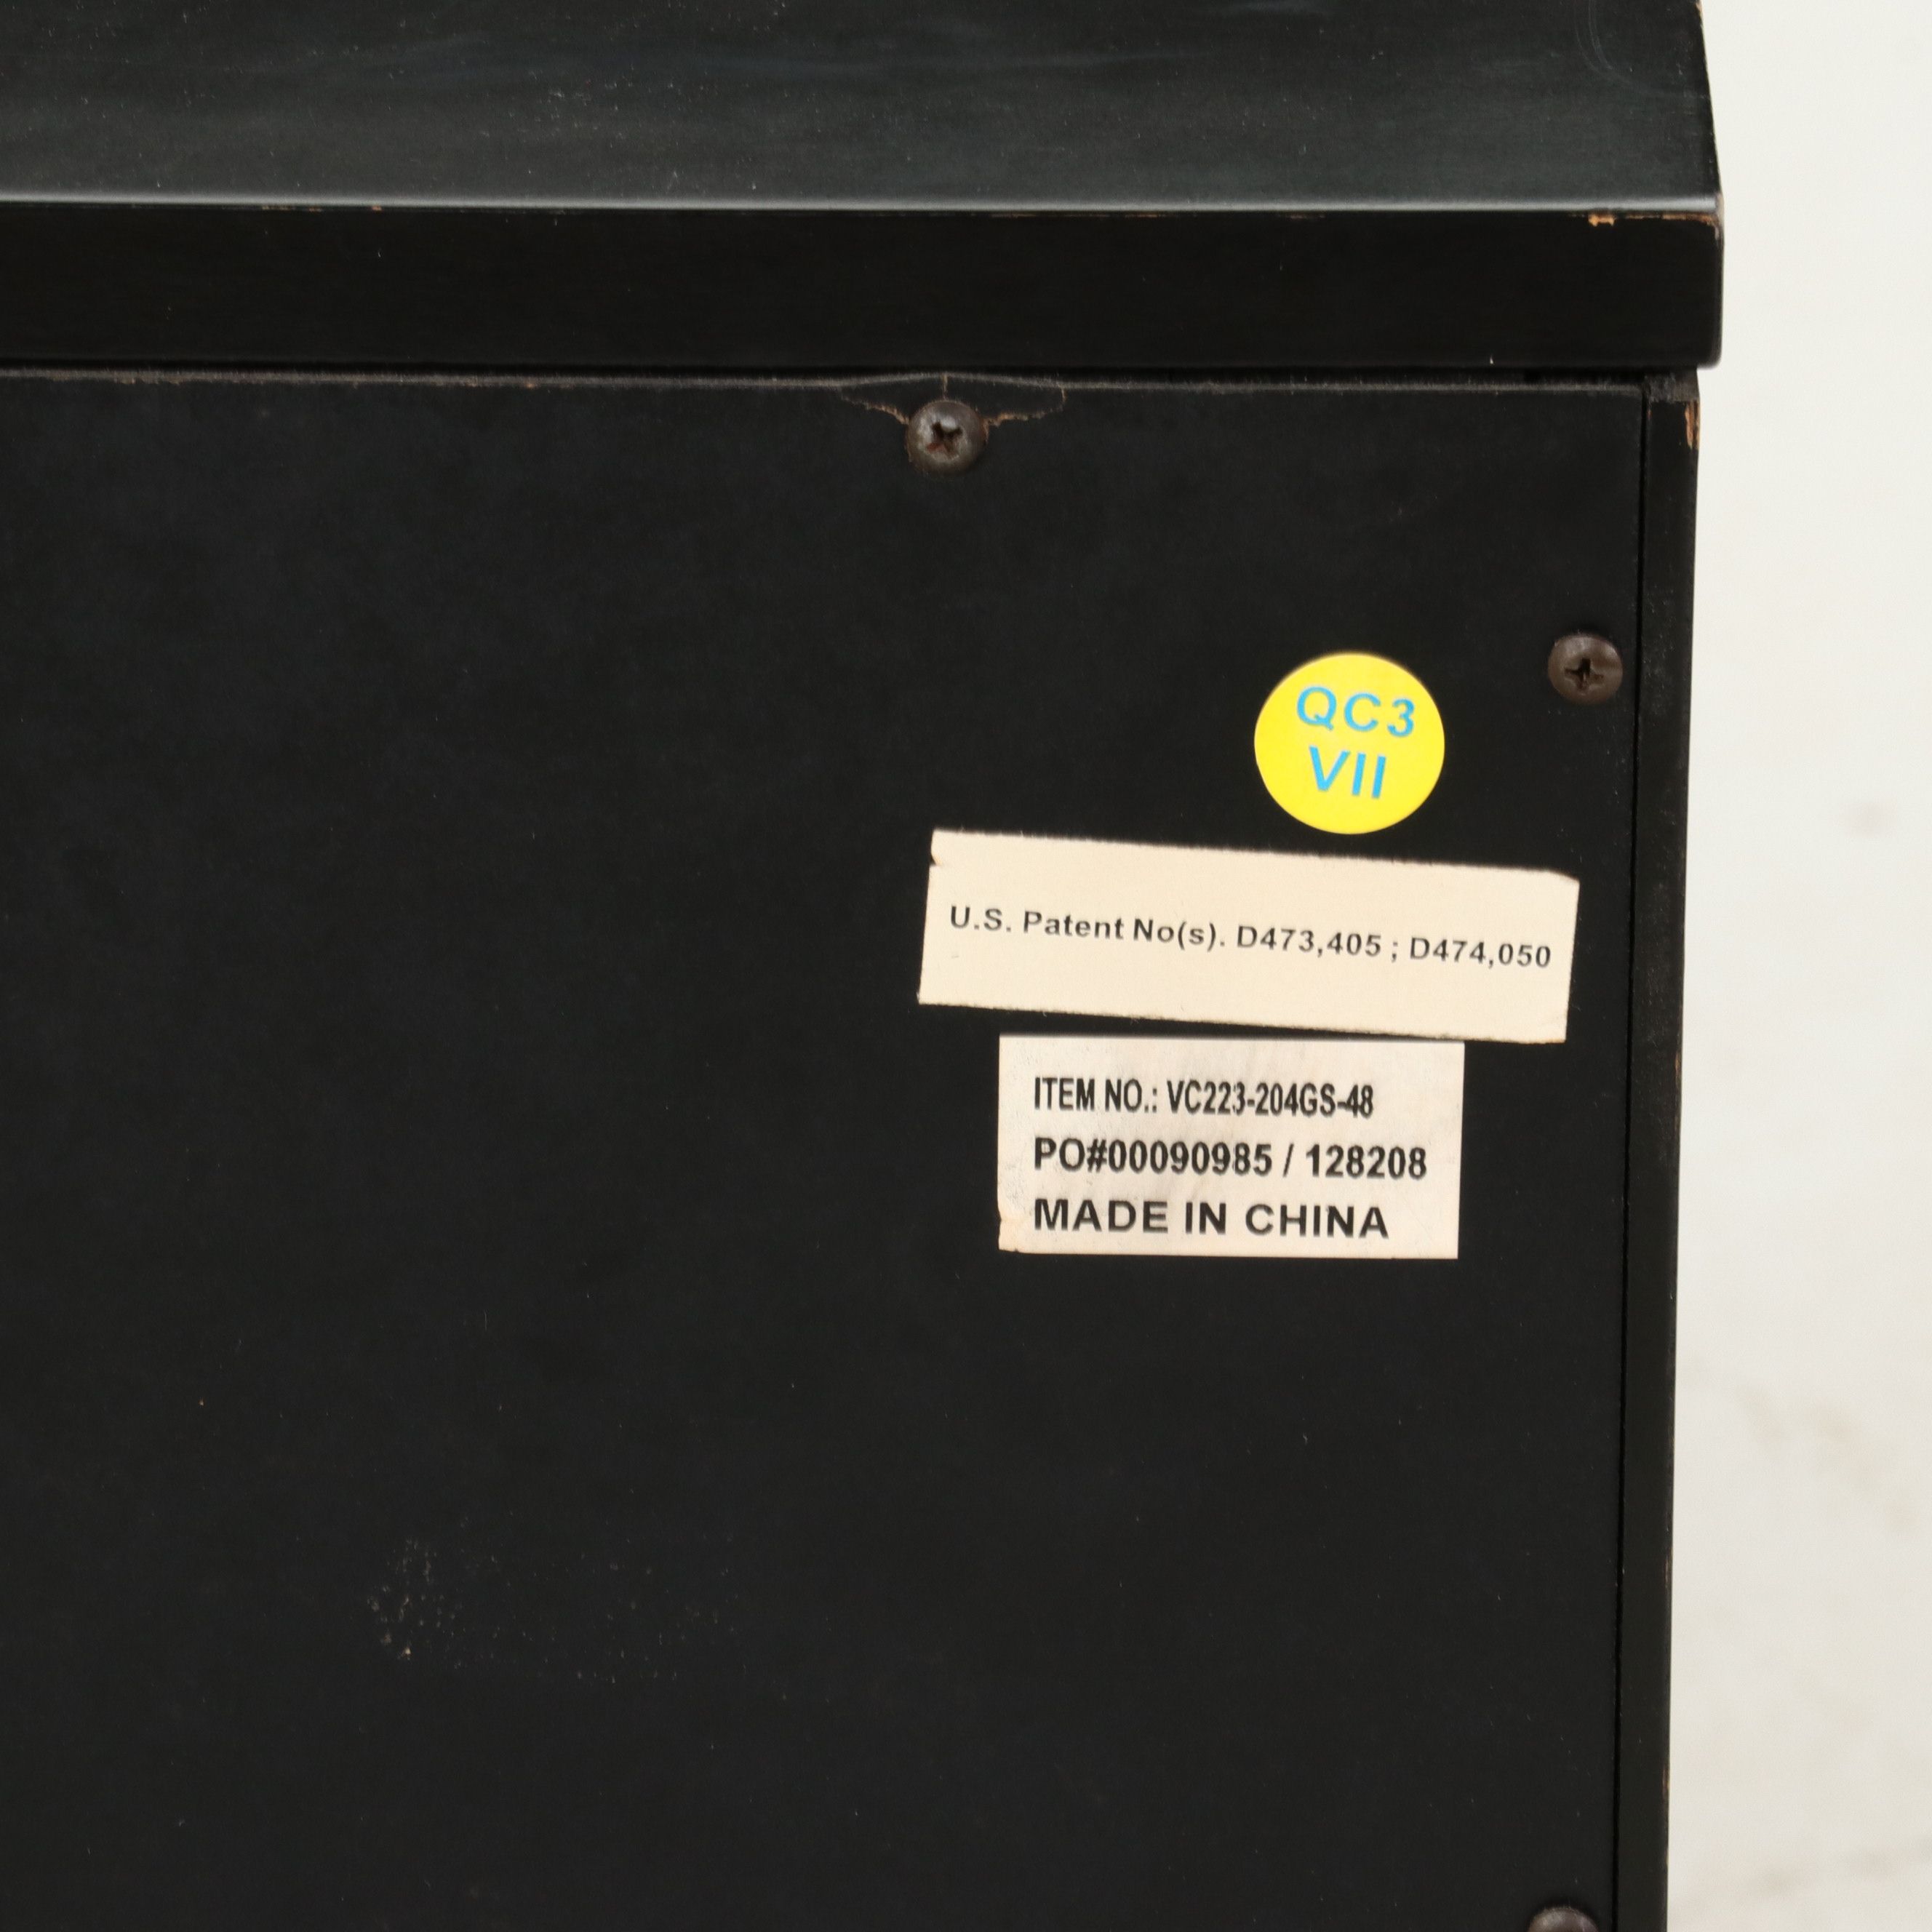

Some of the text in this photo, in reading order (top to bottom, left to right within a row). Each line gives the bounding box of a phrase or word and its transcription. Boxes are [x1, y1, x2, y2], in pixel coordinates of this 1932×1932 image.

[1297, 687, 1415, 737] QC3
[1309, 746, 1386, 798] VII
[950, 905, 1551, 968] U.S. Patent No(s). D473,405 ; D474,050
[1034, 1077, 1373, 1118] ITEM NO.: VC223-204GS-48
[1034, 1136, 1427, 1179] PO#00090985 / 128208
[1034, 1198, 1388, 1238] MADE IN CHINA
